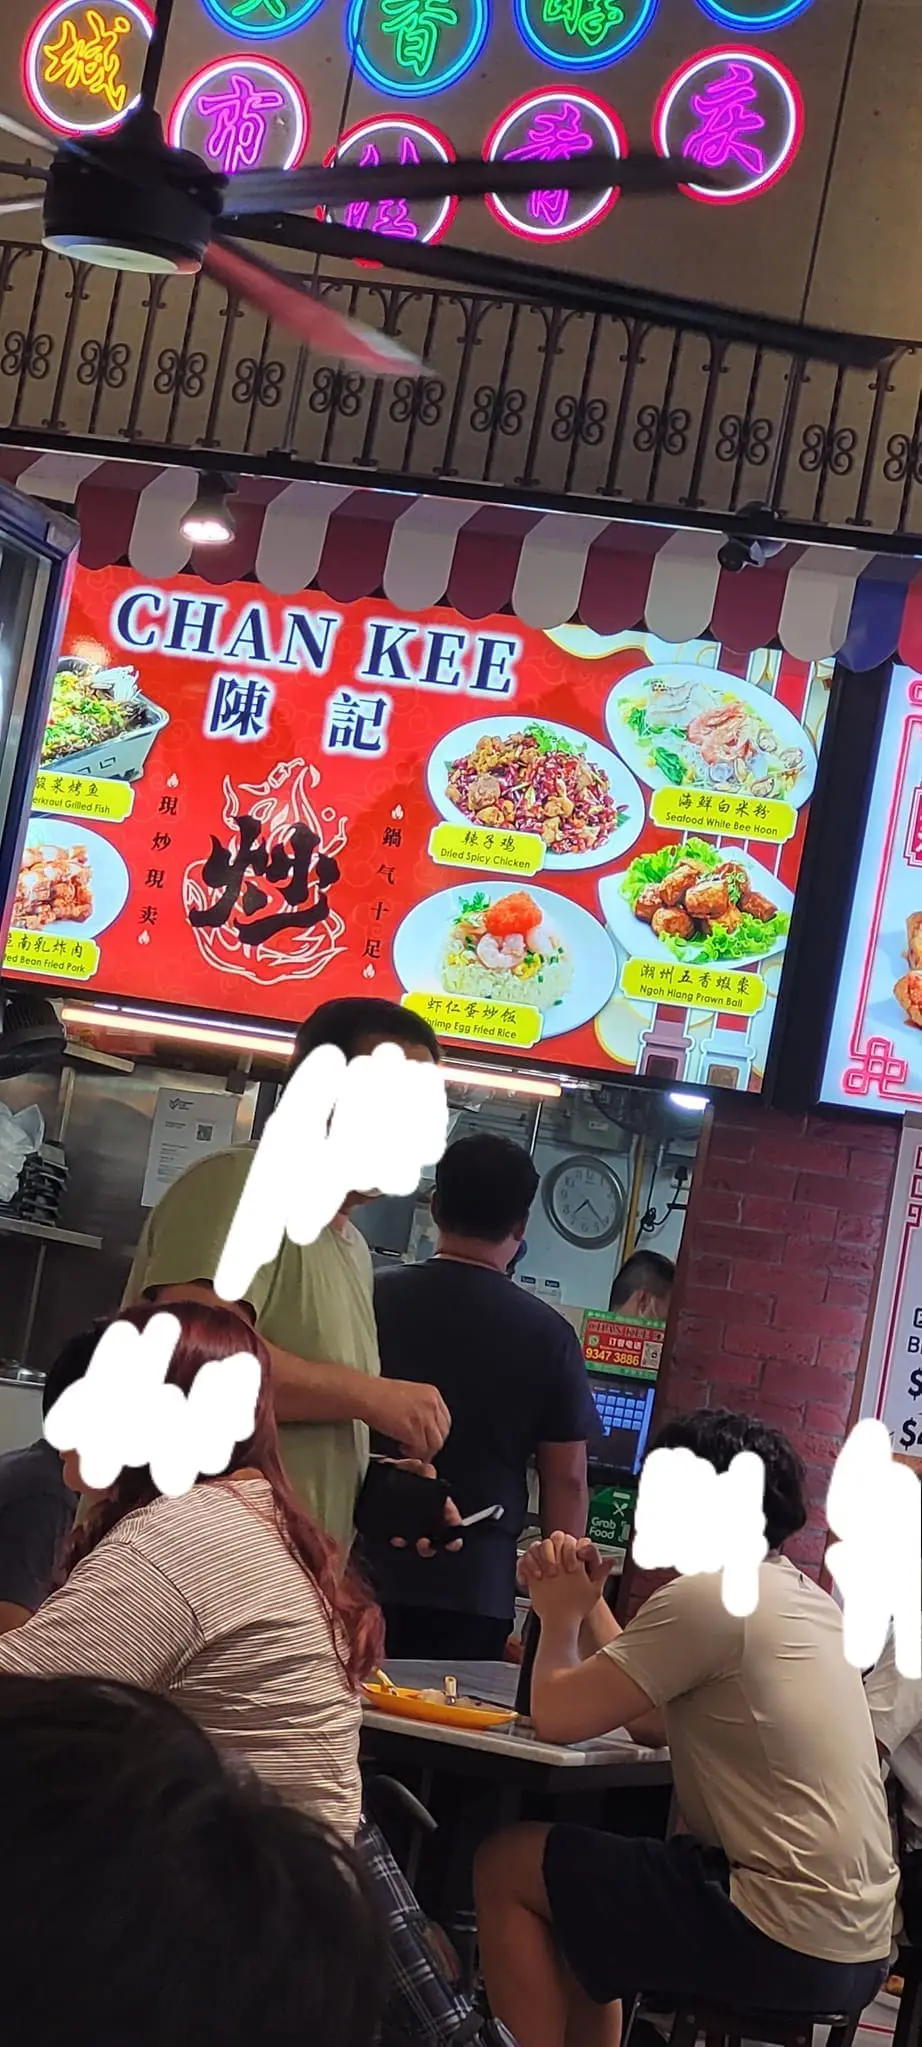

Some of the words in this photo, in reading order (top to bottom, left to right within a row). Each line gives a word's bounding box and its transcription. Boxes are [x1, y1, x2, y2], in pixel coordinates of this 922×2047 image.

[116, 592, 338, 670] CHAN
[361, 622, 517, 694] KEE
[64, 799, 93, 812] Grilled
[94, 804, 110, 814] Fish
[665, 811, 704, 826] Seafood
[706, 817, 732, 829] White
[734, 821, 751, 832] Bee
[753, 824, 778, 836] Hoon
[440, 848, 464, 859] Dried
[466, 852, 491, 865] Spicy
[493, 856, 531, 869] Chicken
[20, 955, 42, 966] Bean
[44, 960, 65, 970] Fried
[66, 962, 86, 973] Pork
[639, 984, 665, 998] Ngoh
[667, 987, 694, 1002] Hiang
[696, 992, 724, 1006] Prawn
[726, 996, 743, 1008] Ball
[427, 997, 517, 1024] 虾仁蛋炒饭
[454, 1022, 471, 1034] Egg
[473, 1024, 495, 1036] Fried
[497, 1028, 517, 1039] Rice
[585, 1347, 612, 1361] 9347
[613, 1352, 640, 1365] 3886
[591, 1516, 616, 1530] Grab
[589, 1526, 615, 1539] Food
